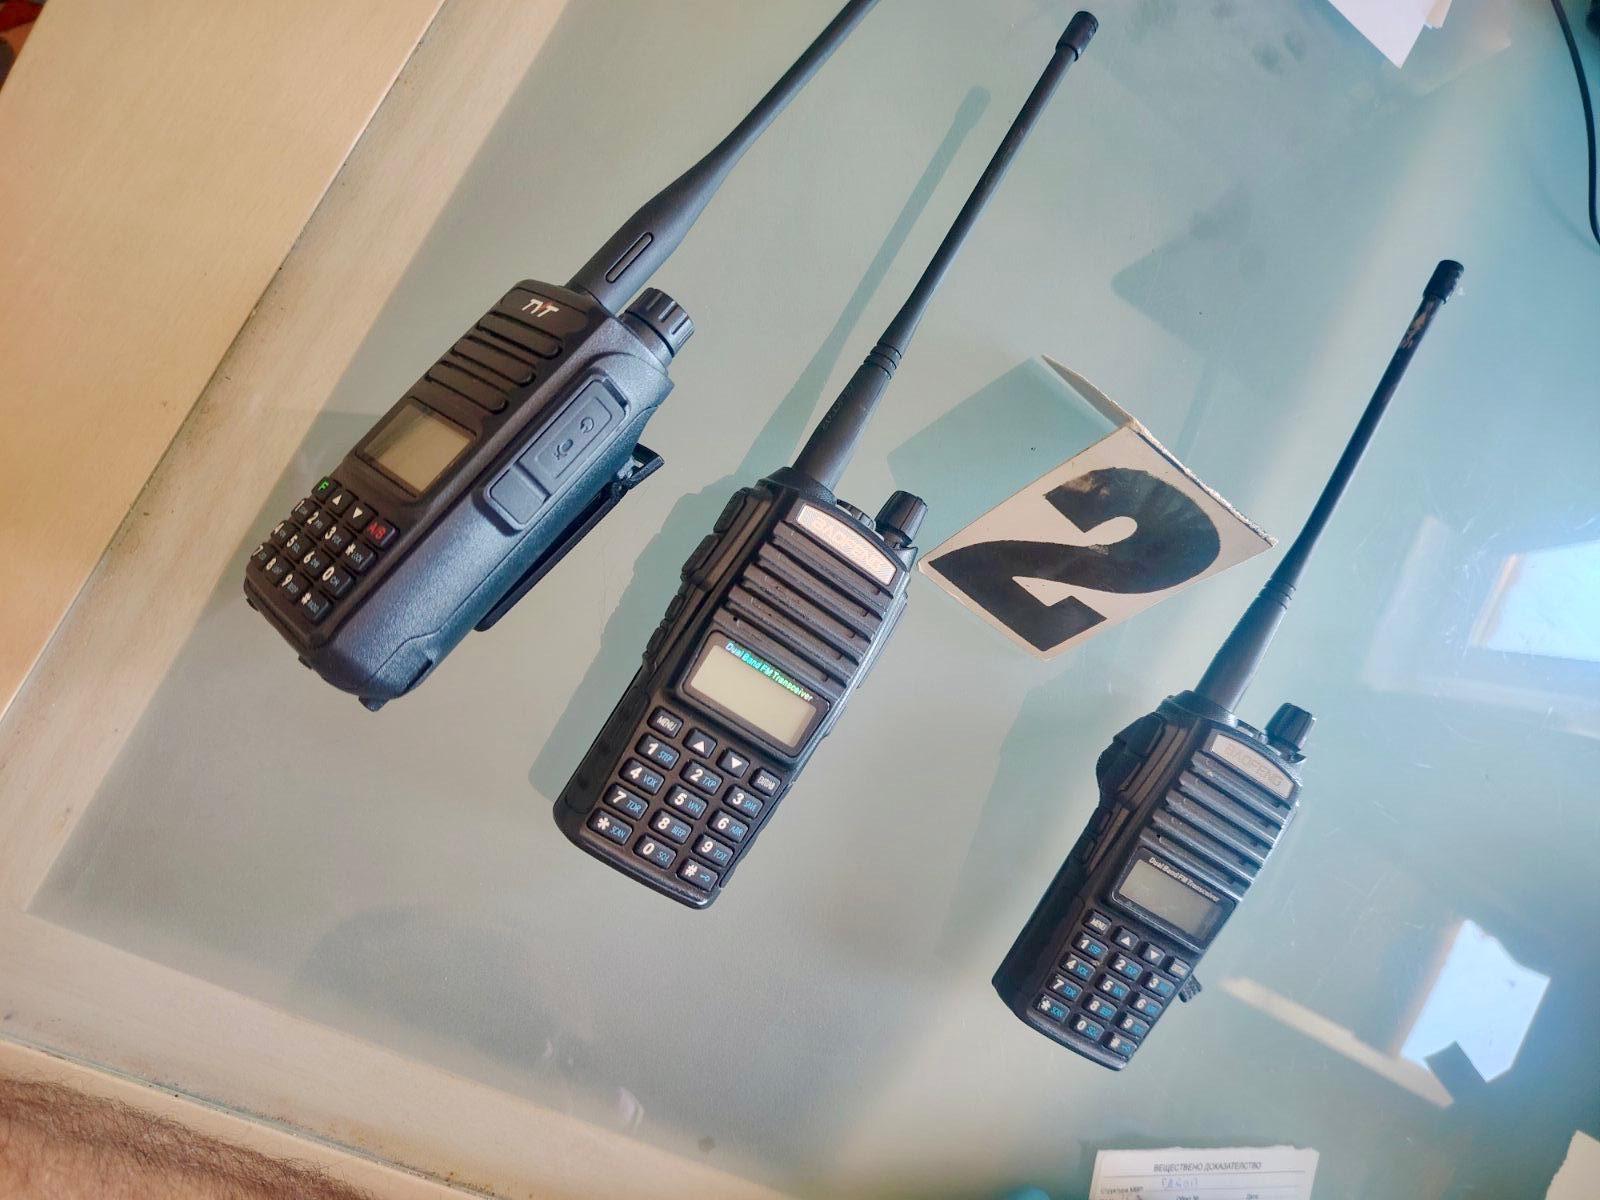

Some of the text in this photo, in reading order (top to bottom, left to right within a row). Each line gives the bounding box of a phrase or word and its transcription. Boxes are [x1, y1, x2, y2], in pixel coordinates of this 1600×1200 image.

[317, 480, 330, 491] F
[294, 500, 305, 511] 1
[306, 511, 319, 525] 2
[324, 526, 337, 540] 3
[286, 534, 298, 548] 5
[266, 557, 277, 571] 8
[303, 551, 315, 564] 6
[929, 467, 1222, 652] 2
[282, 573, 293, 588] 9
[322, 566, 335, 582] 0
[725, 641, 814, 701] Dual Band FM Transceiver
[656, 715, 678, 732] MENU
[647, 742, 659, 756] 1
[630, 766, 643, 780] 4
[690, 769, 704, 782] 2
[612, 790, 627, 804] 7
[674, 792, 688, 805] 5
[732, 793, 745, 805] 3
[658, 817, 670, 830] 8
[717, 817, 730, 830] 6
[642, 842, 655, 855] 0
[701, 841, 714, 853] 9
[1090, 917, 1106, 931] MENU
[1079, 939, 1090, 950] 1
[1066, 959, 1078, 971] 4
[1114, 959, 1127, 971] 2
[1052, 980, 1065, 991] 7
[1102, 979, 1114, 991] 5
[1148, 976, 1159, 988] 3
[1089, 1000, 1101, 1011] 8
[1136, 998, 1147, 1009] 6
[1076, 1019, 1088, 1031] 0
[1123, 1018, 1135, 1029] 9
[1153, 1160, 1262, 1173] ВЕЩЕСТВЕНО ДОКАЗАТЕЛСТВО
